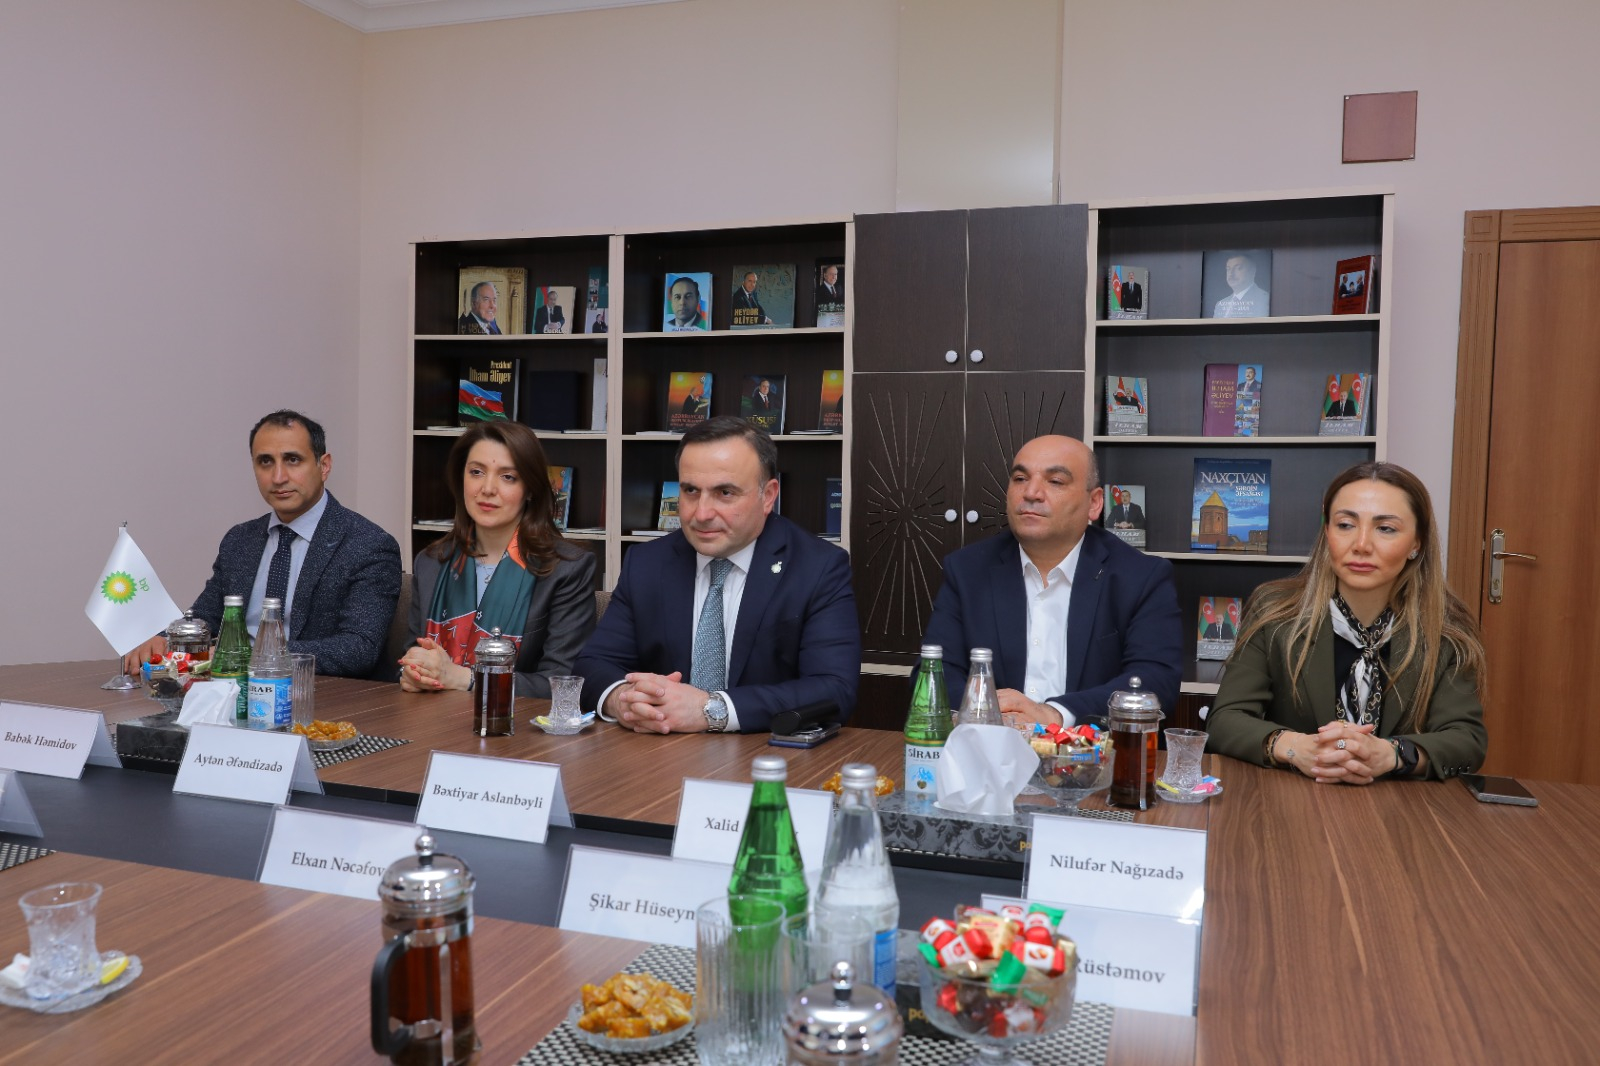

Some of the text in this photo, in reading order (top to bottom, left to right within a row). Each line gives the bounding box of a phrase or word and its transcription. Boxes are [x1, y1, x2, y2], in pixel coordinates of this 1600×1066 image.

[138, 577, 150, 592] bp
[4, 731, 78, 750] Babək Həmidov
[193, 752, 284, 773] Aytən Əfəndizadə
[908, 747, 940, 759] SİRAB
[432, 783, 543, 811] Bəxtiyar Aslanbəyli
[704, 816, 740, 833] Xalid
[291, 851, 387, 878] Elxan Nəcəfov
[1049, 854, 1184, 880] Nilufər Nağızadə
[588, 893, 631, 912] Şikar
